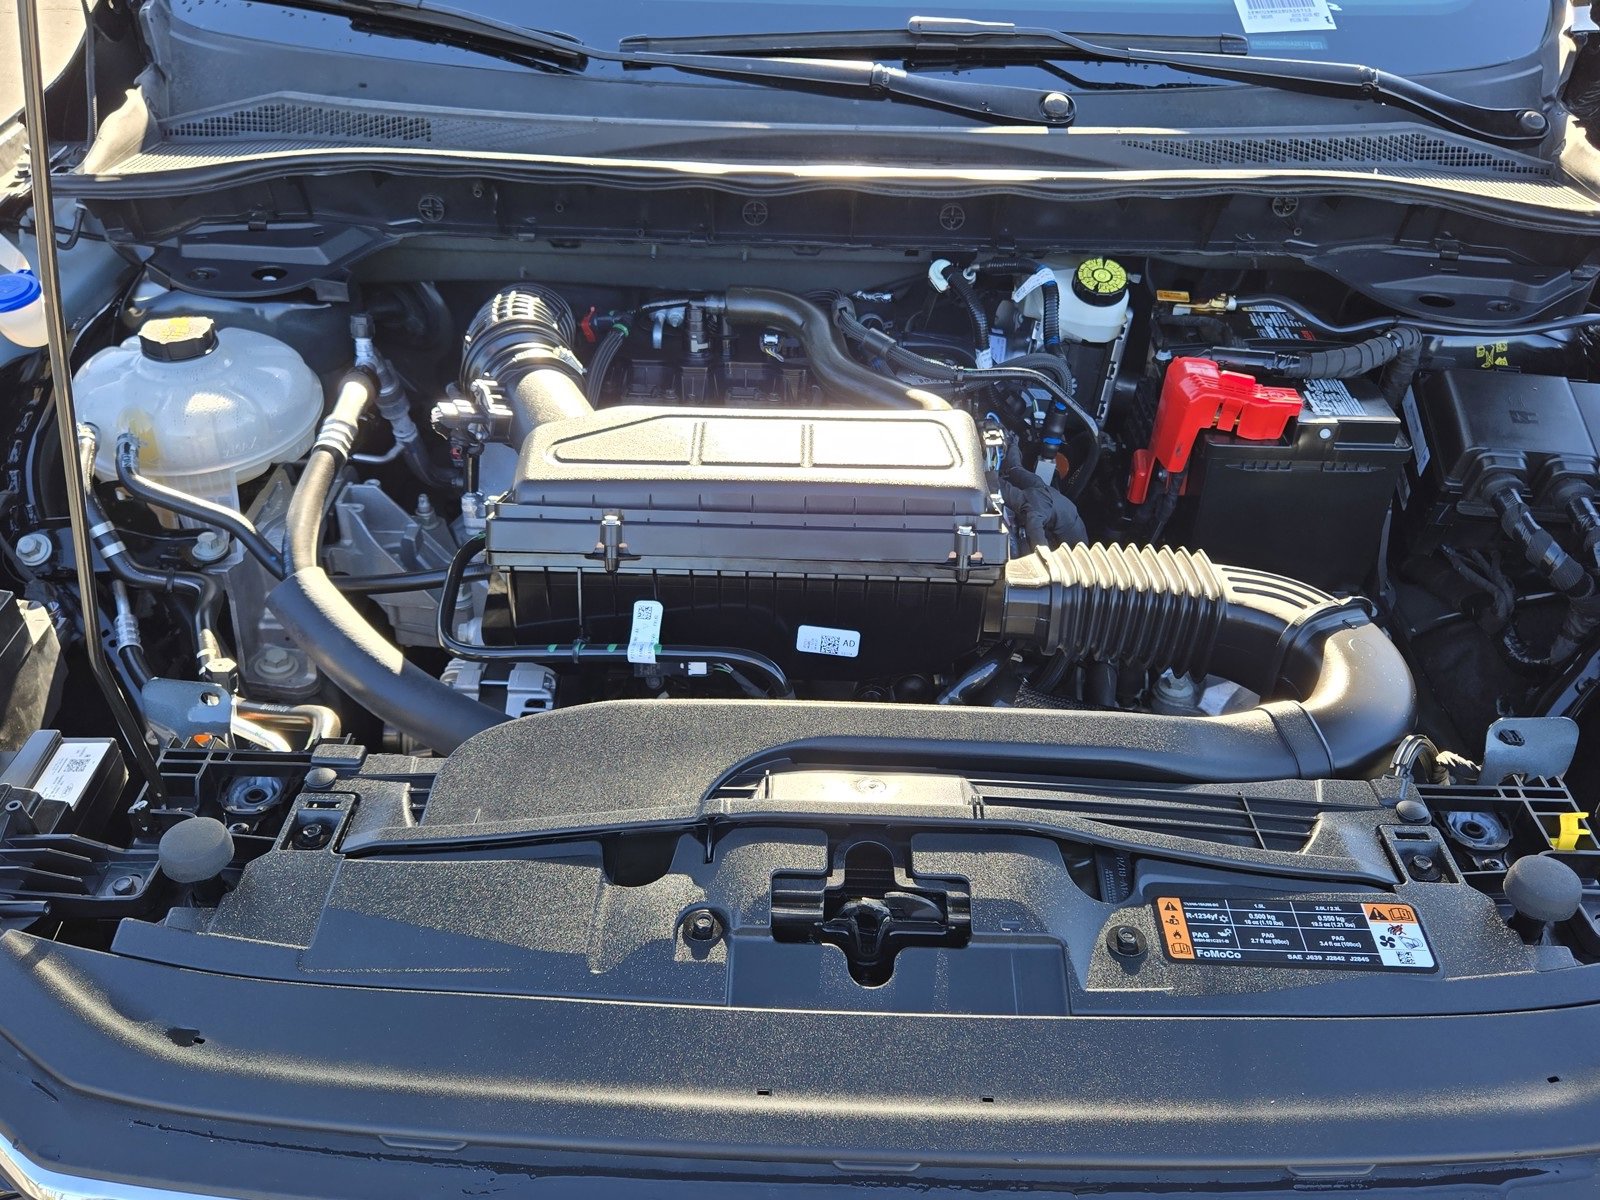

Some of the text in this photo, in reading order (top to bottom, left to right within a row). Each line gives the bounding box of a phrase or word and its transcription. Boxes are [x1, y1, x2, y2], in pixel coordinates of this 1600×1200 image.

[843, 640, 856, 648] AD
[1186, 912, 1218, 921] R-1234yf
[1197, 949, 1241, 959] FoMoCo
